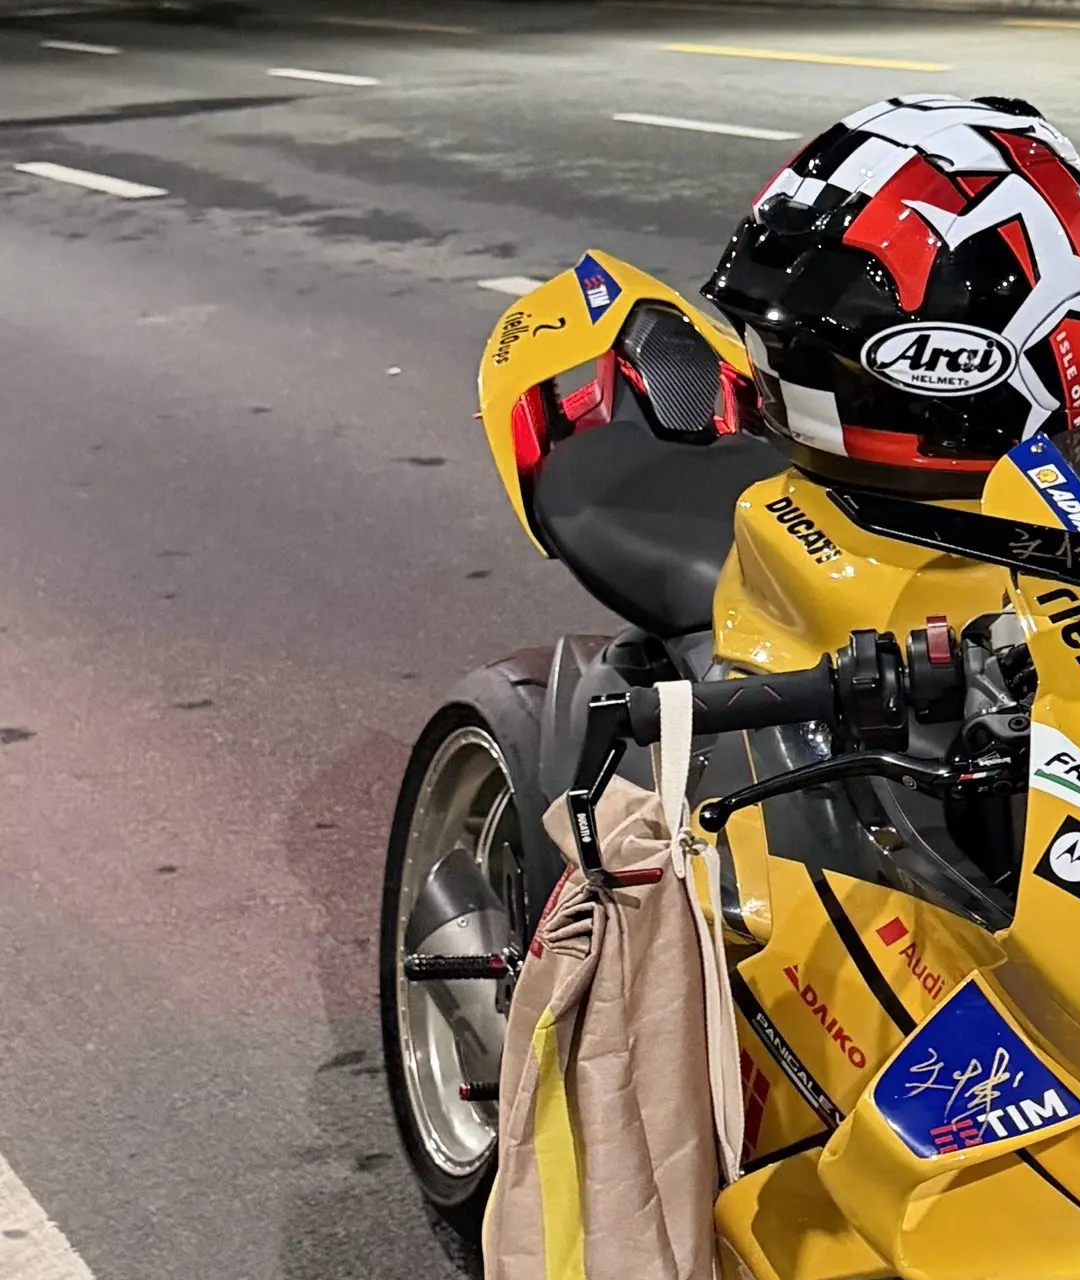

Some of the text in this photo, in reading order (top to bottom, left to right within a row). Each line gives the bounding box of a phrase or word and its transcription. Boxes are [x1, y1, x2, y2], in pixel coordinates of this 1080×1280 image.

[874, 333, 998, 371] Arai
[1055, 331, 1077, 381] ISLE
[765, 496, 843, 564] DUCATI
[899, 941, 945, 1000] Audi
[976, 1088, 1069, 1138] TIM
